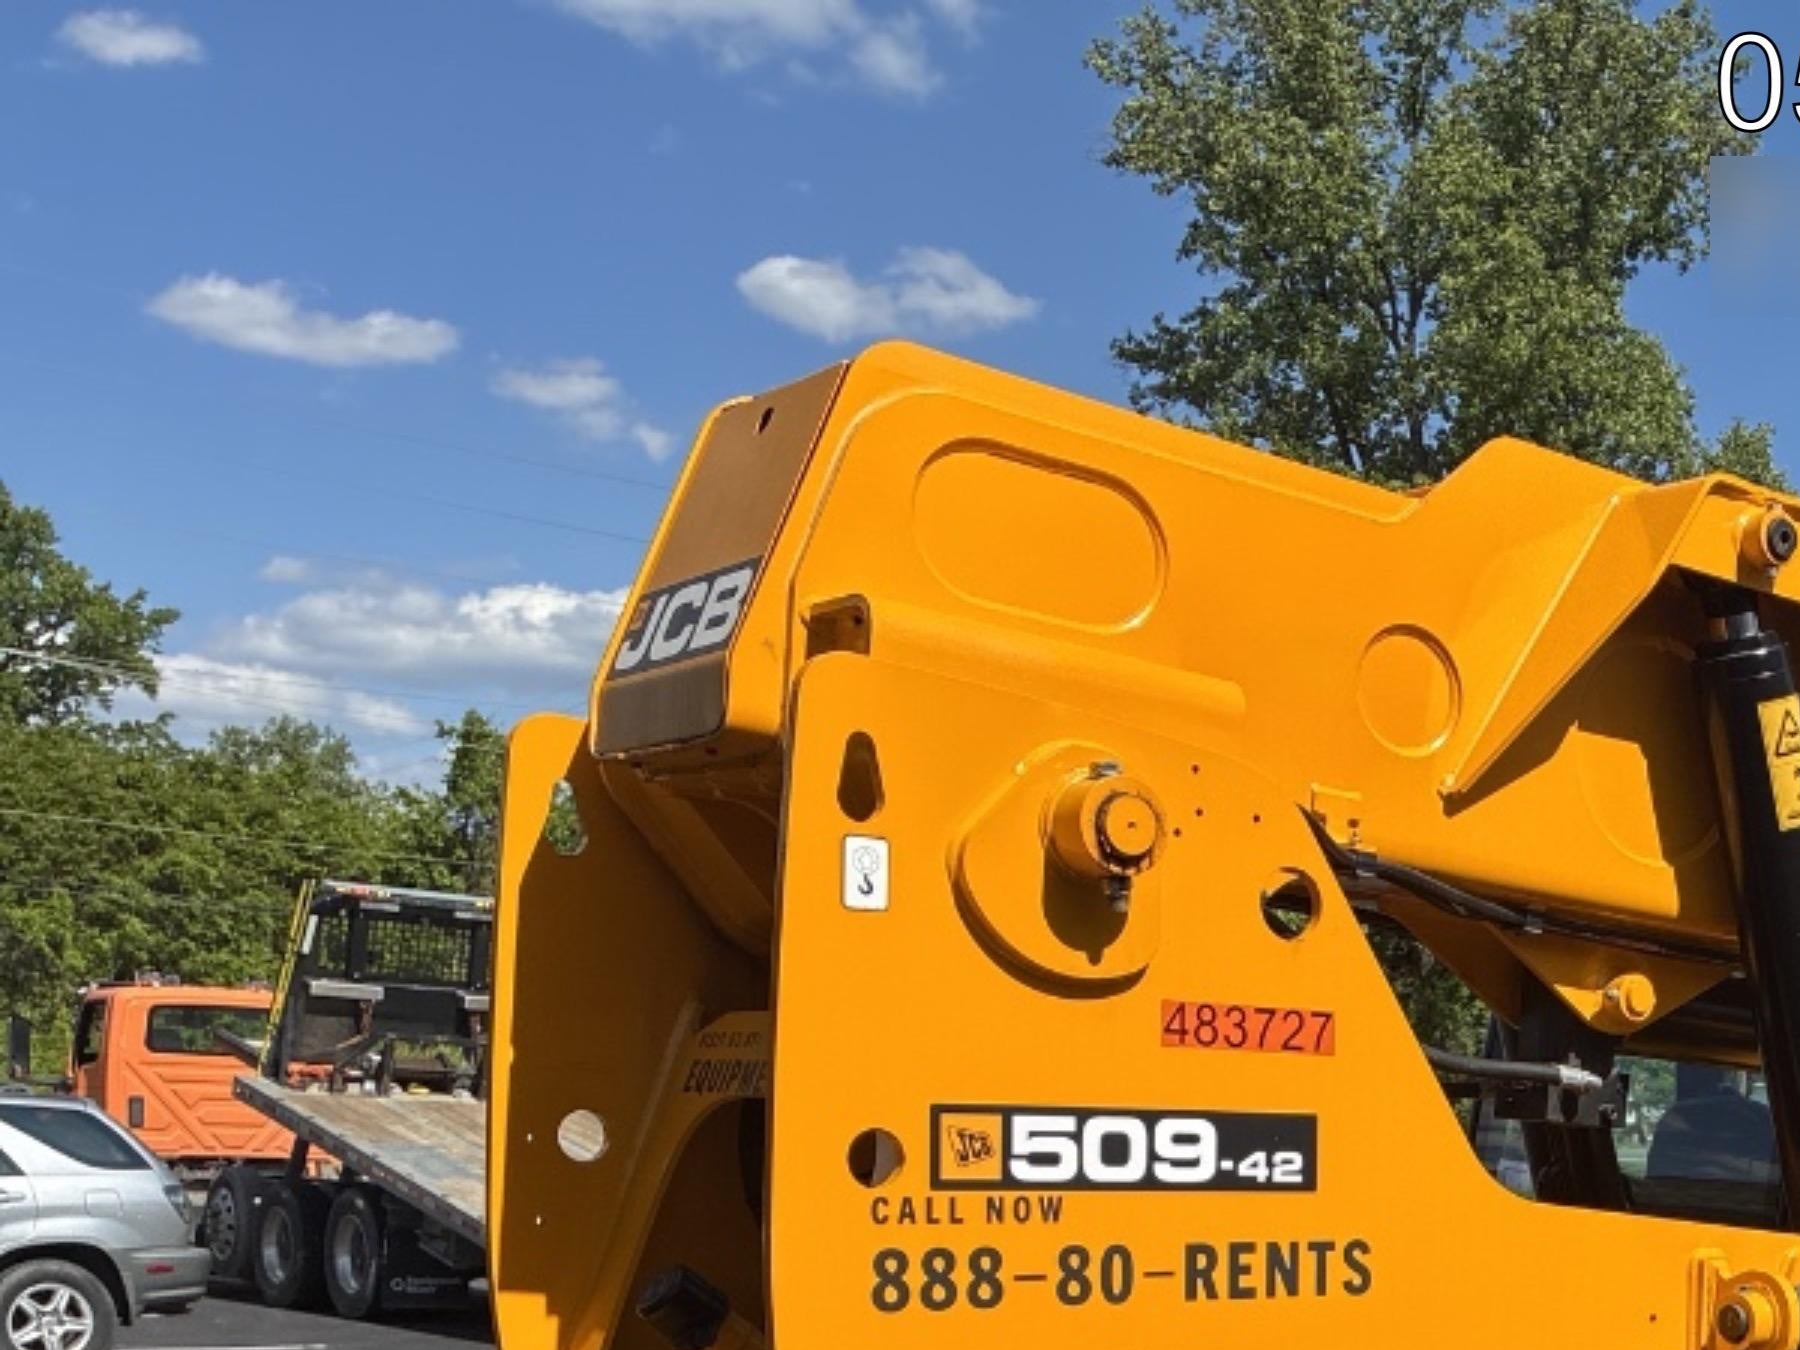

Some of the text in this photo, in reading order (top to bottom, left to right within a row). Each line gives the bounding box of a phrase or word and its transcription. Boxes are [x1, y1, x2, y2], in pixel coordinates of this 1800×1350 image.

[615, 567, 754, 670] JCB
[1163, 1003, 1333, 1052] 483727
[1008, 1114, 1303, 1184] 509-42
[871, 1195, 1063, 1225] CALL NOW
[871, 1239, 1373, 1312] 888-80-RENTS
